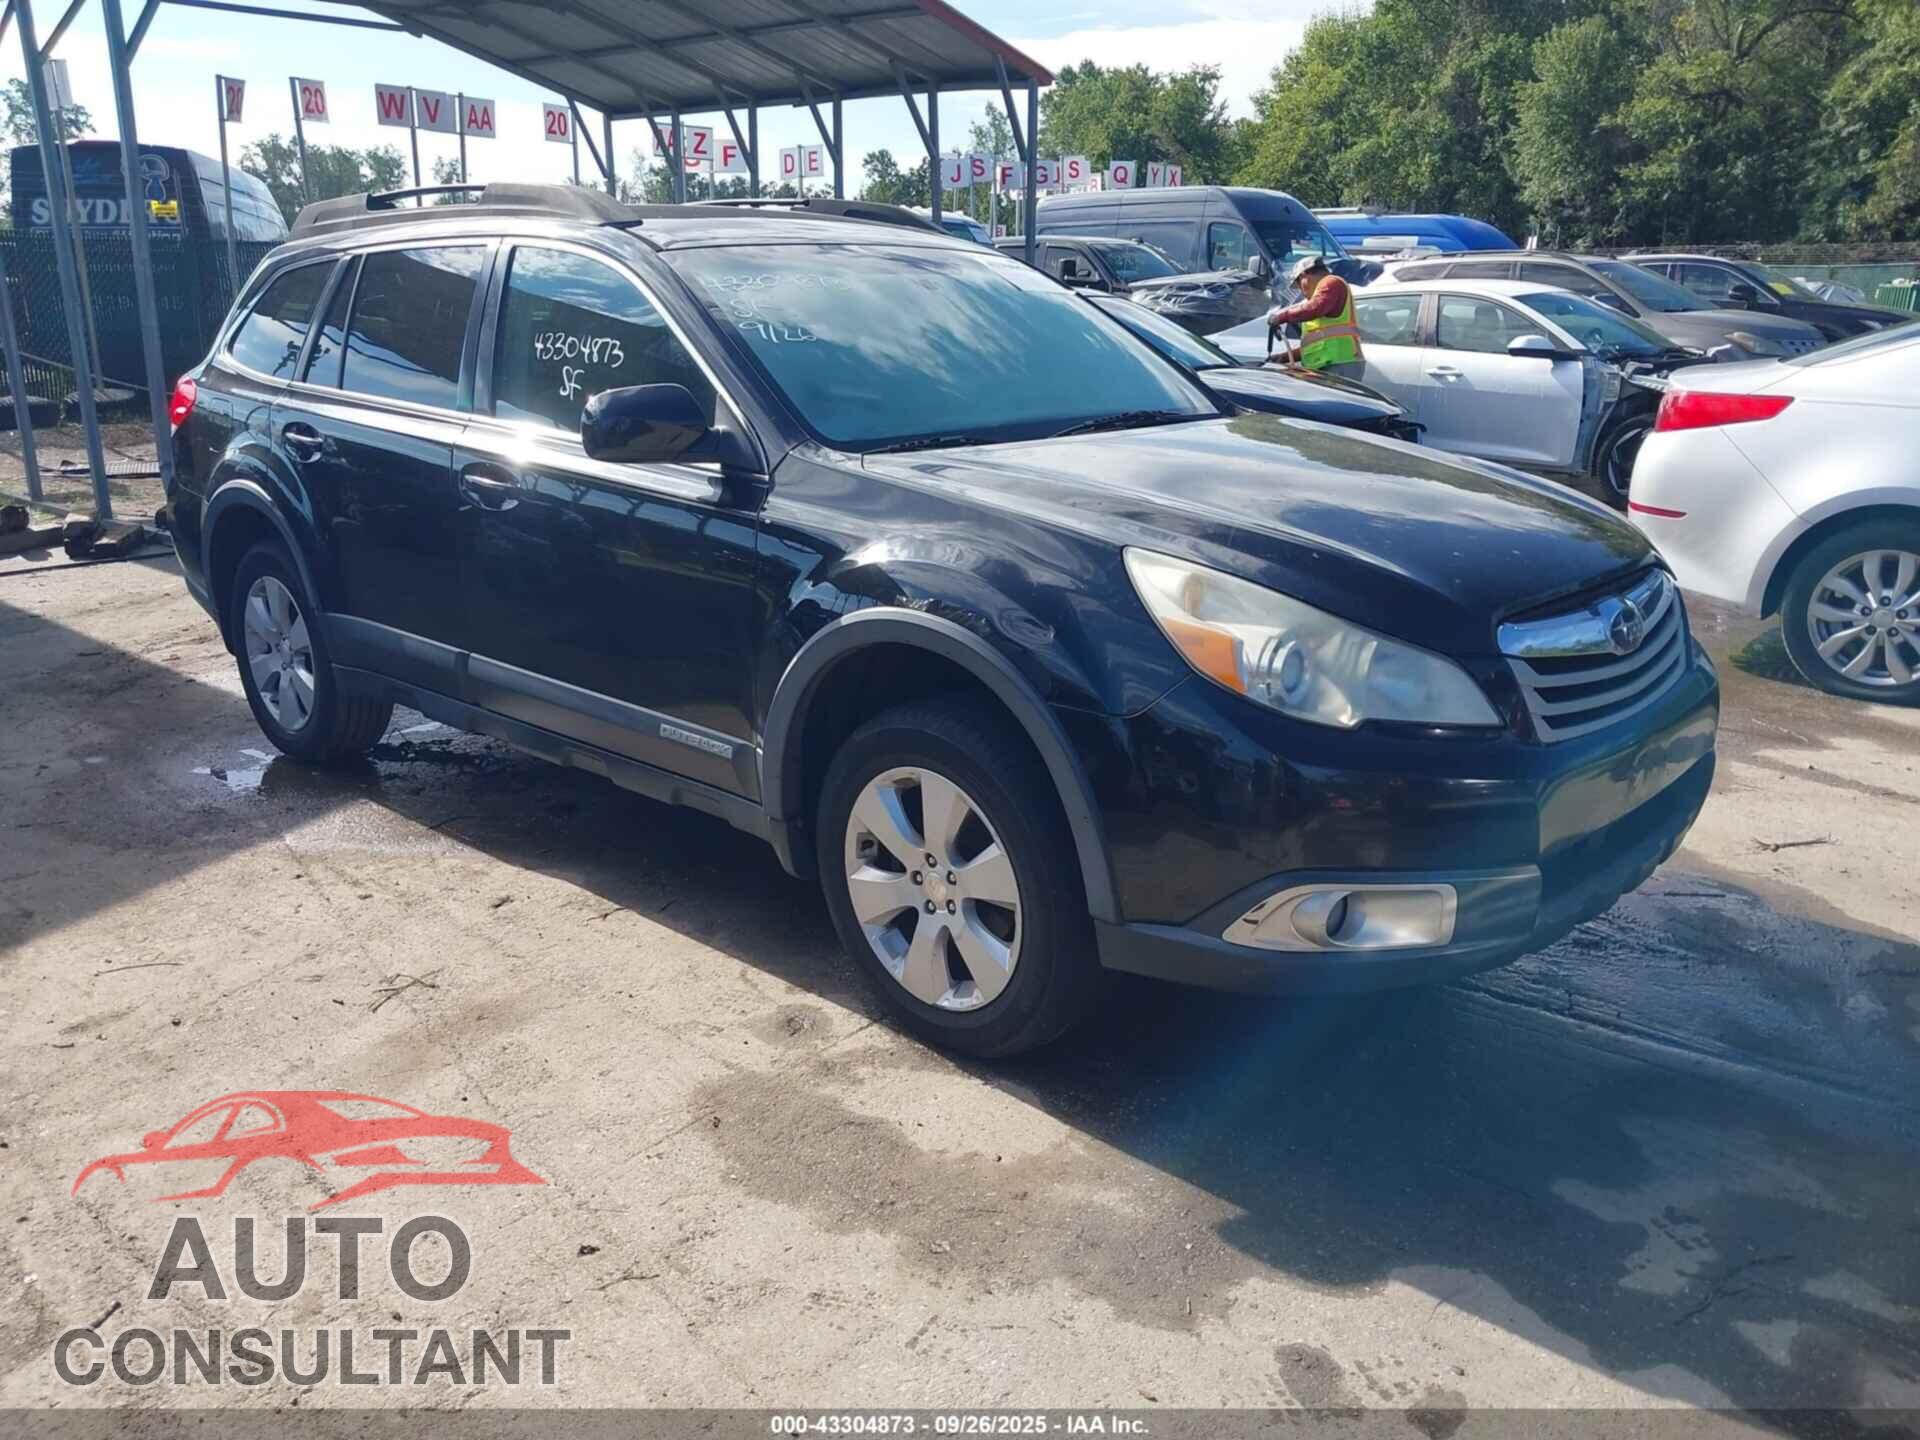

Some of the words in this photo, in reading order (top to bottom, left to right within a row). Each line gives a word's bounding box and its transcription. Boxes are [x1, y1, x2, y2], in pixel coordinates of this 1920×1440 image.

[302, 86, 326, 115] 20
[377, 91, 405, 120] W
[421, 96, 441, 124] V
[466, 105, 493, 130] AA
[545, 111, 568, 136] 20
[693, 132, 707, 155] Z
[722, 145, 737, 167] F
[783, 153, 795, 174] D
[808, 151, 819, 172] E
[950, 164, 961, 183] J
[972, 158, 985, 177] S
[1001, 166, 1014, 185] F
[1036, 165, 1049, 184] G
[1068, 160, 1080, 179] S
[1113, 165, 1128, 185] Q
[1151, 167, 1160, 185] Y
[1168, 169, 1178, 187] X
[534, 332, 625, 368] 43304873
